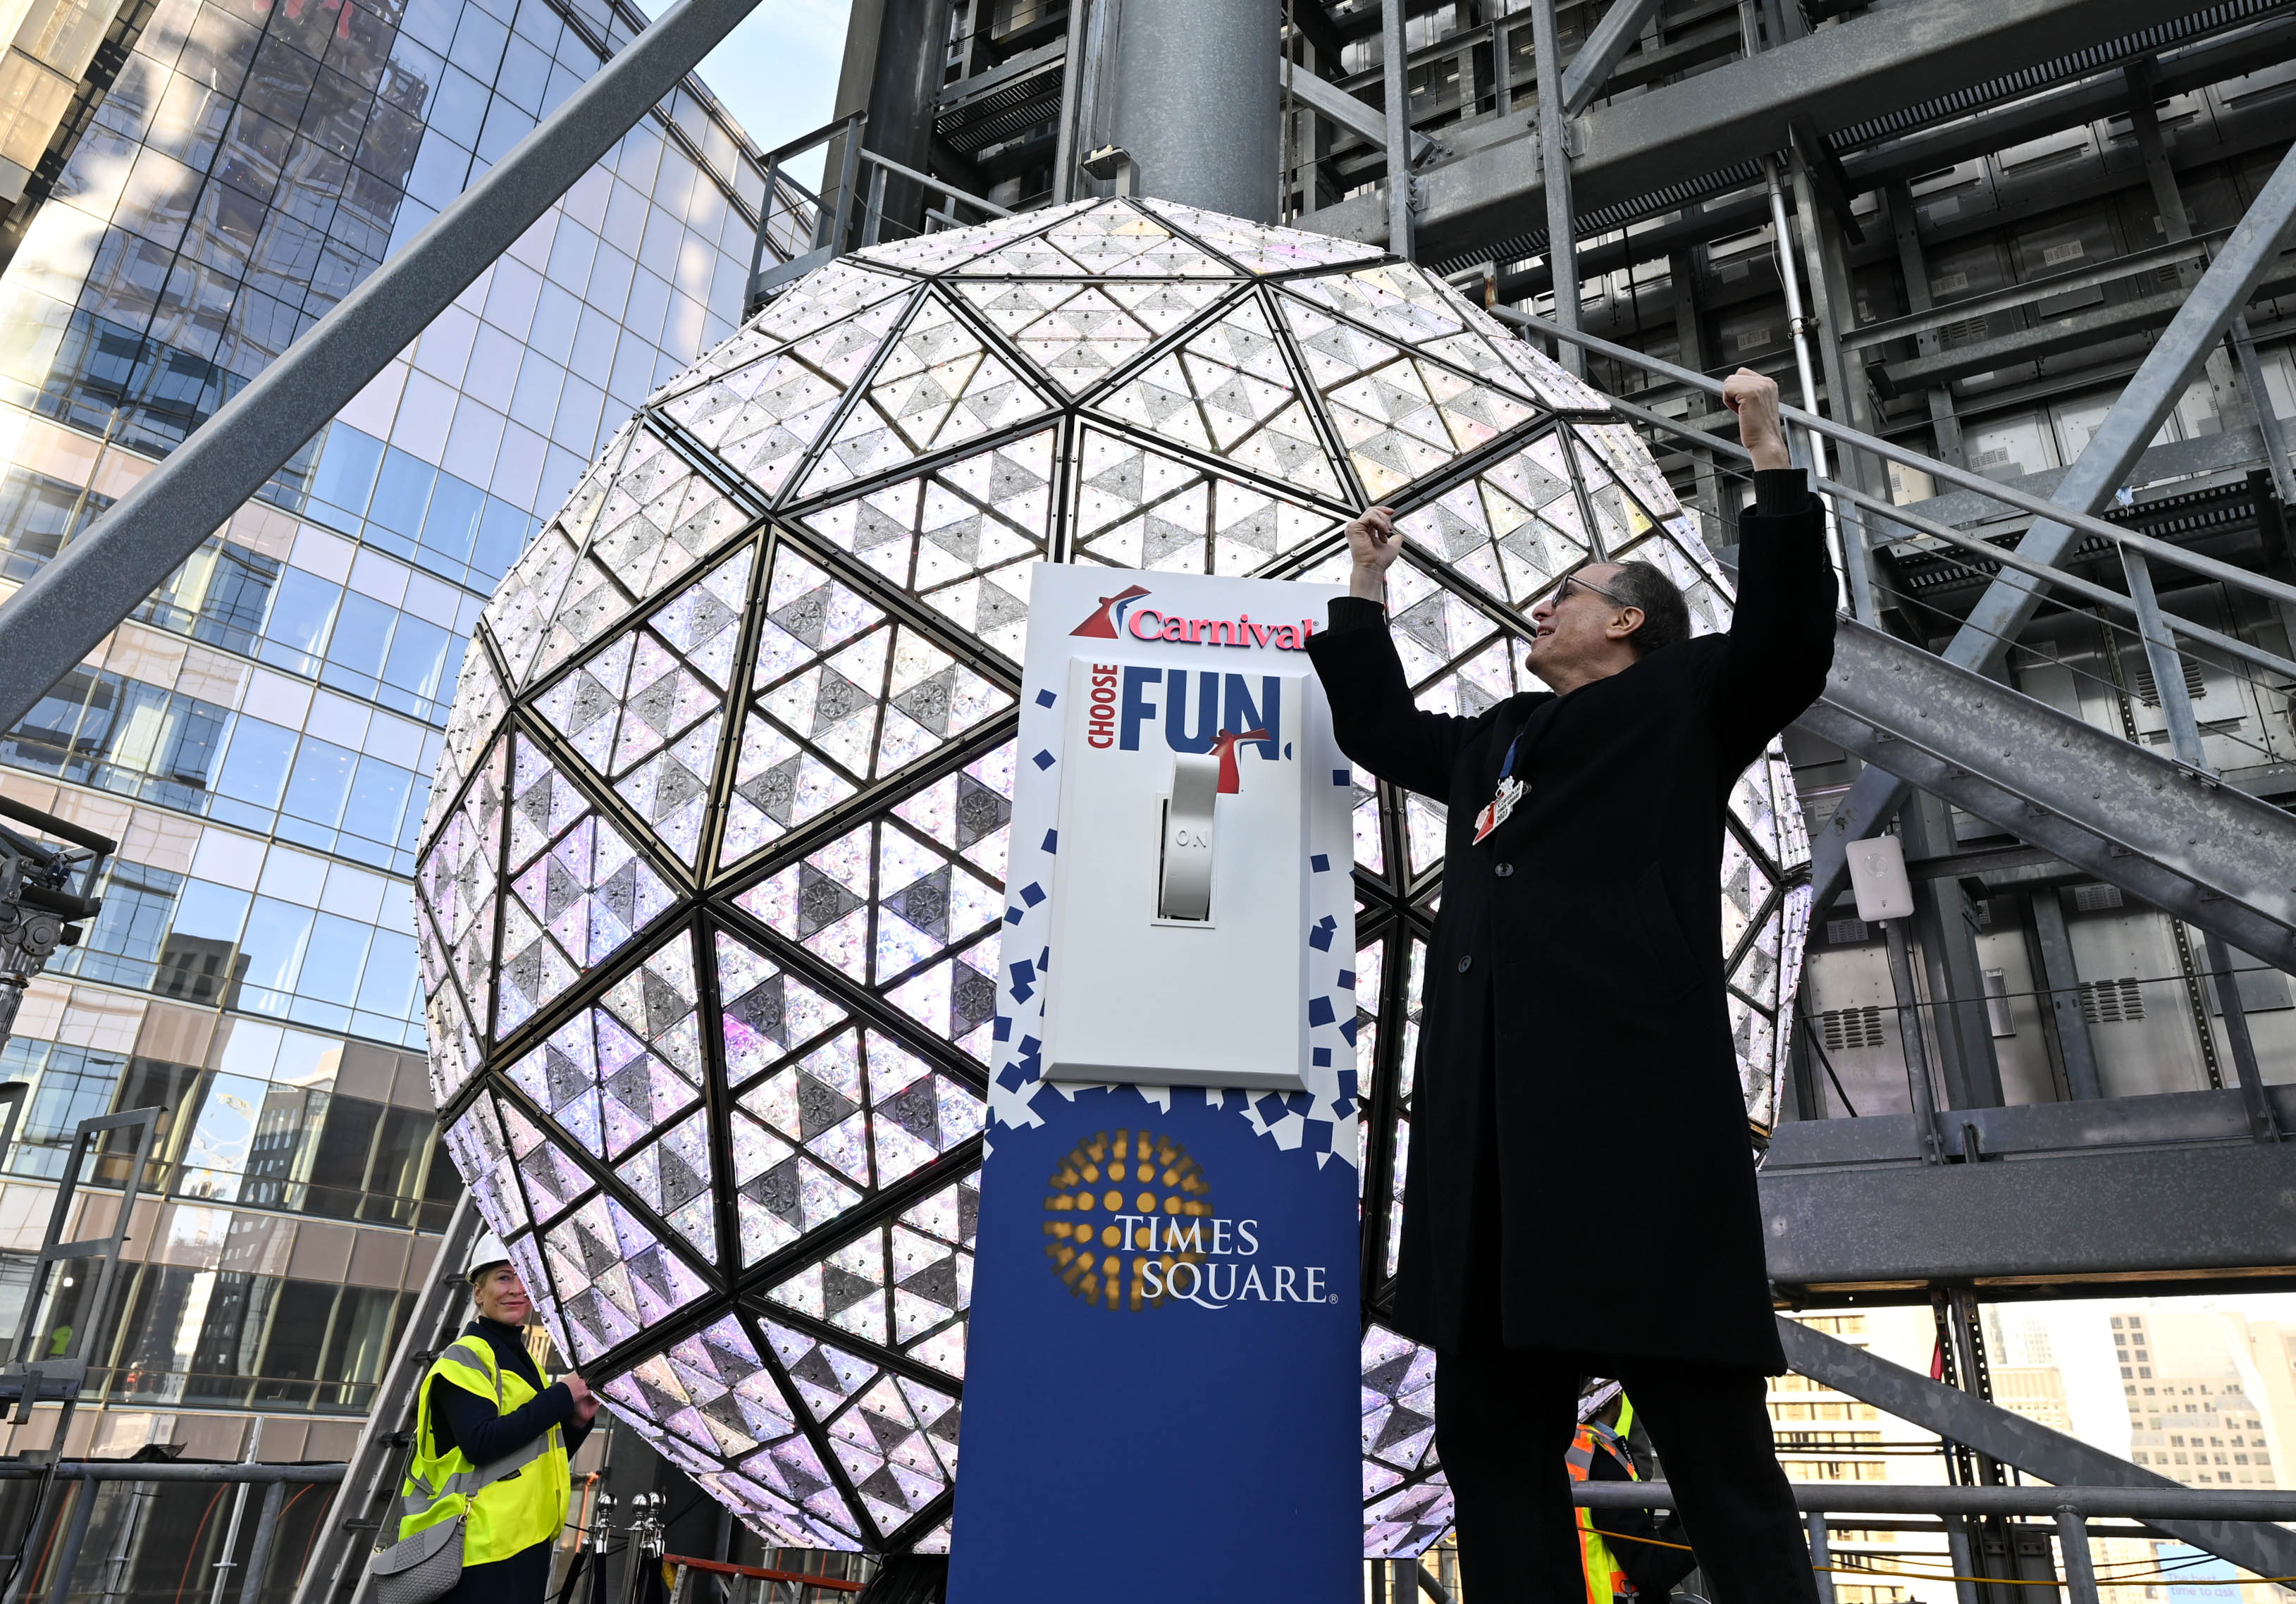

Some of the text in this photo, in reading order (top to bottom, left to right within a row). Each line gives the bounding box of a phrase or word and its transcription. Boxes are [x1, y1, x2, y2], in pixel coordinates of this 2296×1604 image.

[1128, 609, 1313, 651] Carnival
[1087, 663, 1118, 749] CHOOSE
[1175, 829, 1207, 849] ON
[1114, 1214, 1259, 1256] TIMES
[1141, 1260, 1326, 1309] SQUARE
[2199, 1587, 2211, 1596] to
[2215, 1586, 2235, 1596] ask
